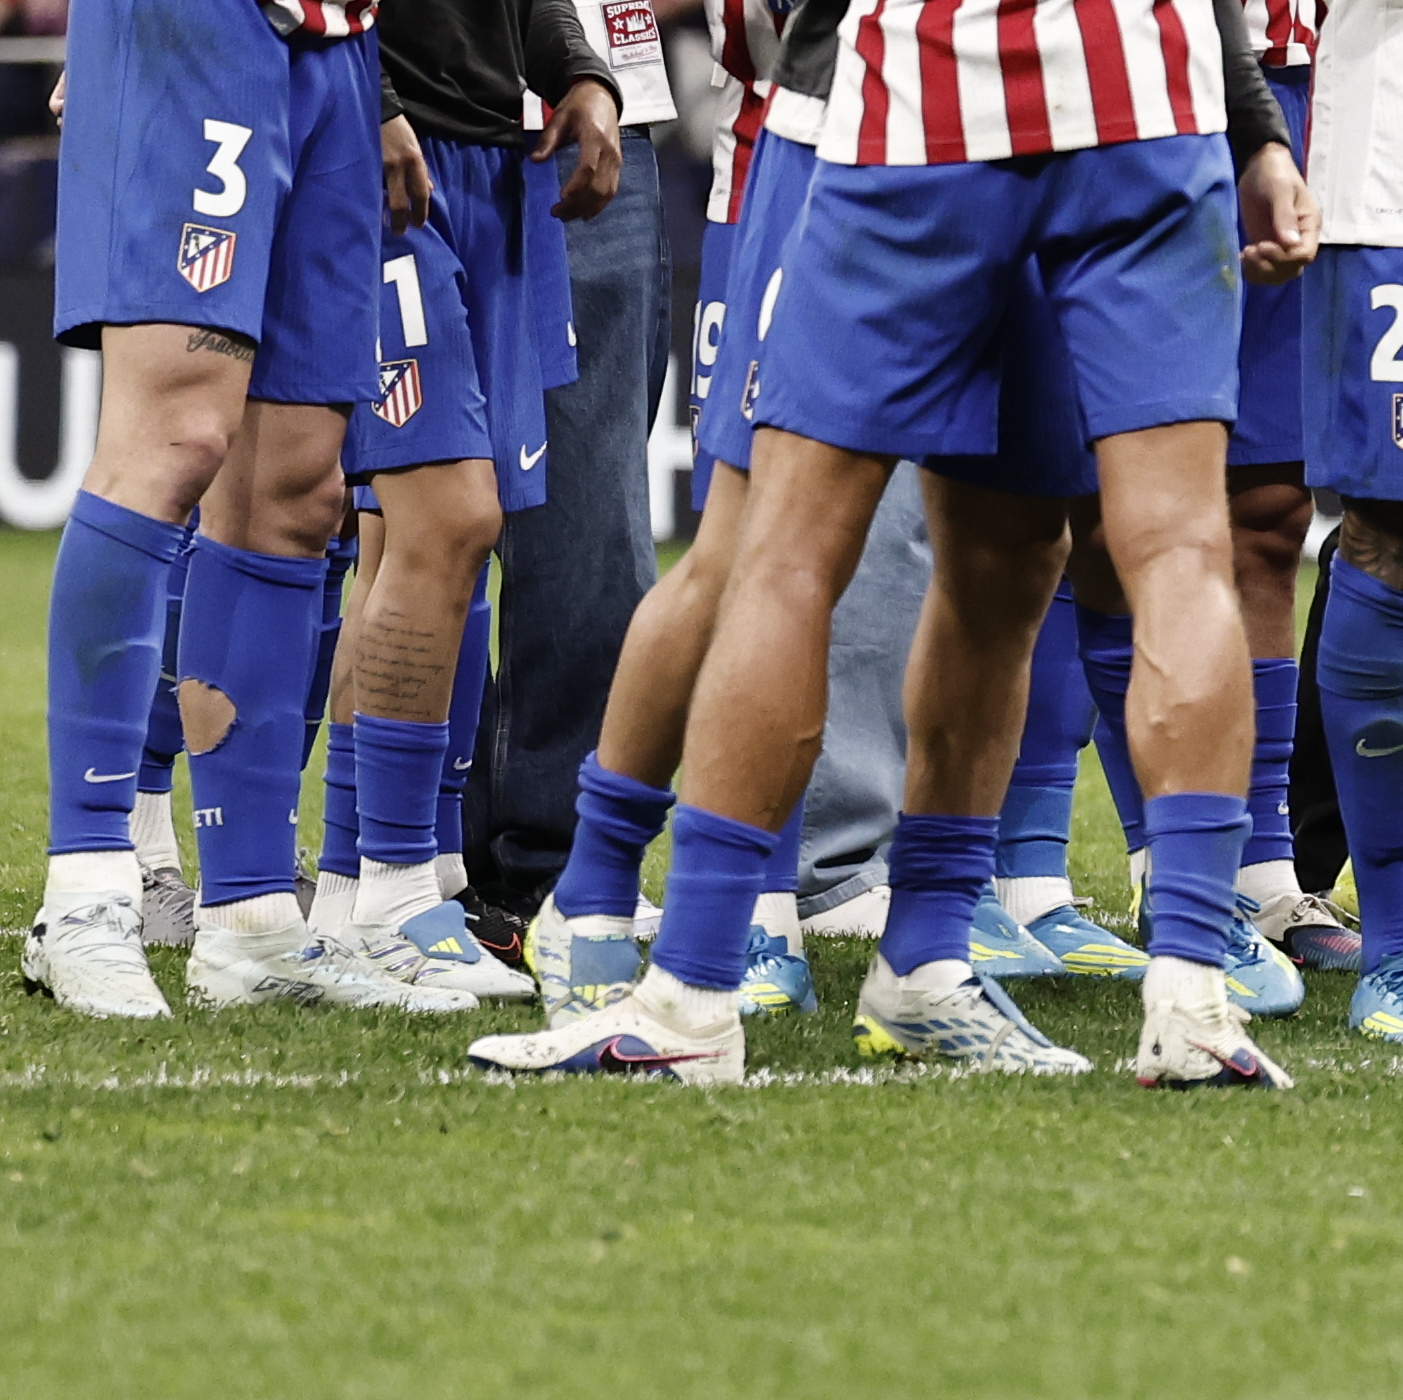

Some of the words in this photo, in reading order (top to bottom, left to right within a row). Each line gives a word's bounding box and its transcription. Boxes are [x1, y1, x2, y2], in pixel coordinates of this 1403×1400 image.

[193, 119, 254, 217] 3
[376, 253, 428, 363] 1
[192, 807, 224, 829] ETI
